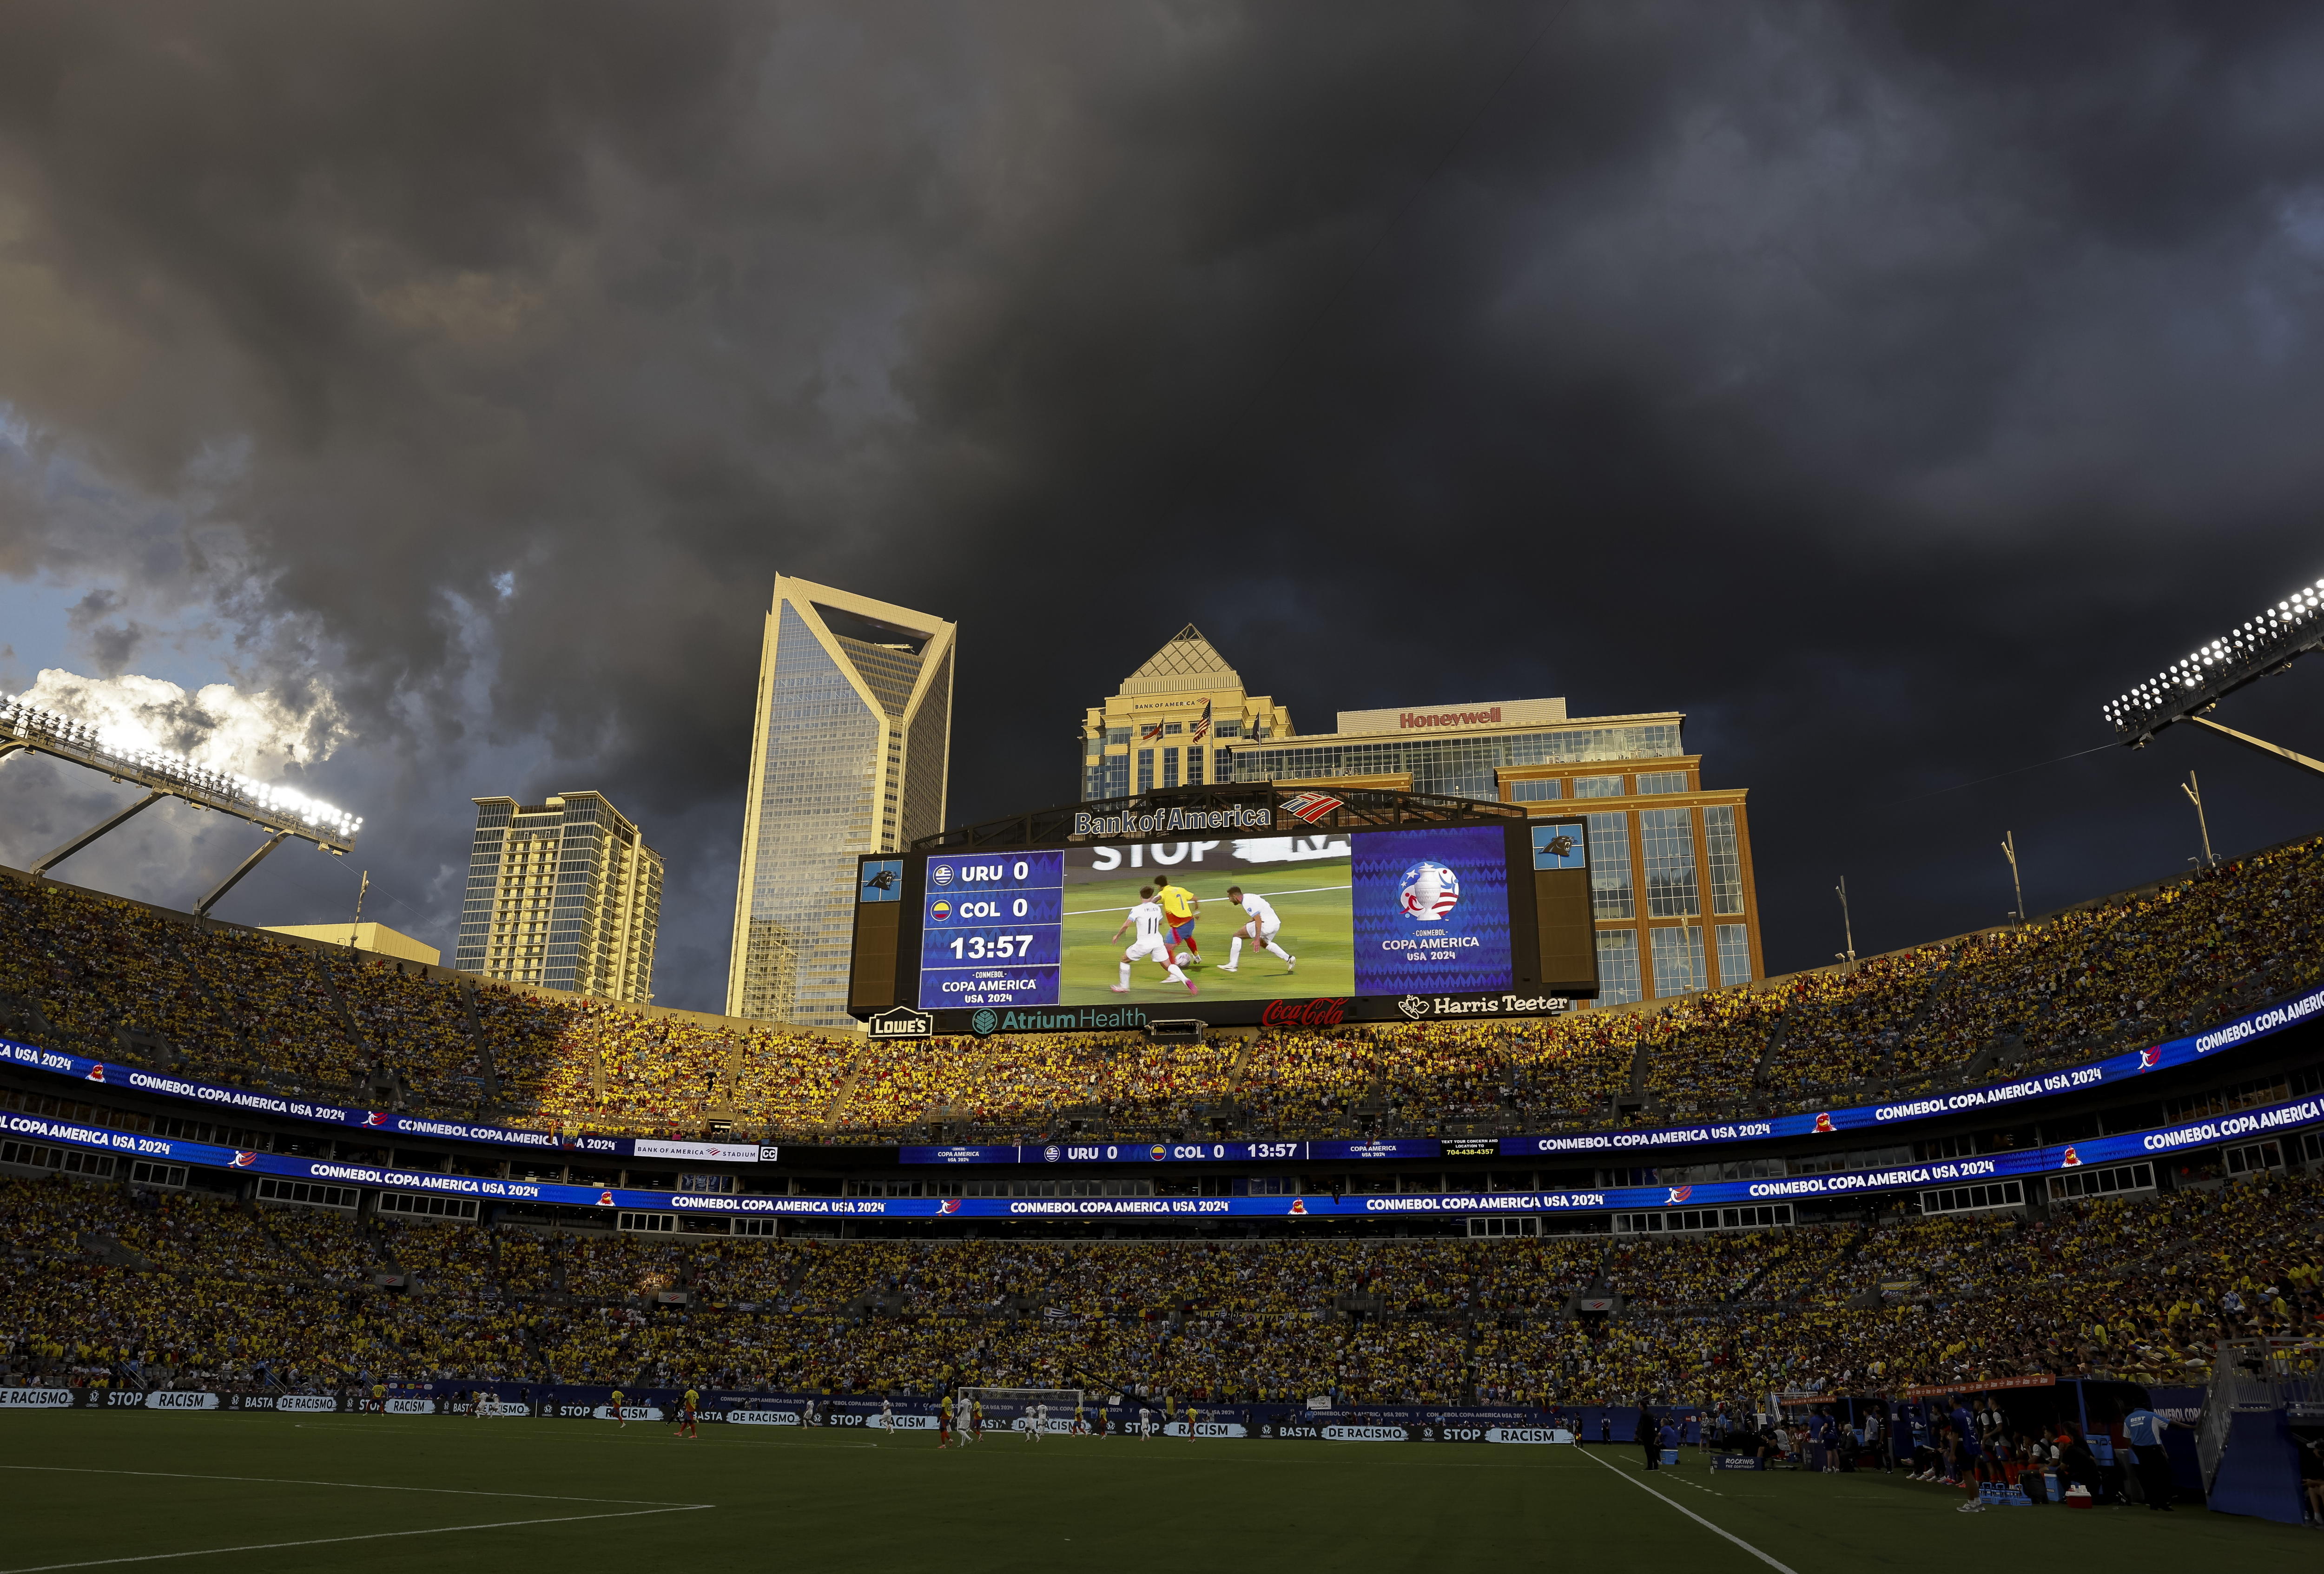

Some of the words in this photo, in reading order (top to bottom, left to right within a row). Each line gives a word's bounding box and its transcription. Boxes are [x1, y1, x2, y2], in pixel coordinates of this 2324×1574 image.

[1400, 707, 1501, 728] Honeywell
[1075, 810, 1137, 835] Bank
[1139, 808, 1165, 831] of
[1167, 804, 1271, 830] America
[962, 865, 1003, 881] URU
[1014, 862, 1028, 879] 0
[960, 902, 1000, 918] COL
[1013, 899, 1027, 916] 0
[1176, 894, 1184, 911] 7
[1148, 917, 1157, 934] 11
[951, 935, 1033, 959] 13:57
[1382, 940, 1417, 950] COPA
[1420, 937, 1479, 948] AMERICA
[1407, 952, 1426, 961] USA
[1431, 951, 1455, 960] 2024
[943, 981, 976, 992] COPA
[978, 980, 1036, 991] AMERICA
[965, 994, 984, 1003] USA
[988, 994, 1011, 1002] 2024
[1434, 997, 1498, 1014] Harris
[1502, 995, 1567, 1011] Teeter
[1002, 1010, 1075, 1030] Atrium
[1081, 1008, 1146, 1028] Health
[1262, 997, 1349, 1026] Coca-Cola
[2196, 1021, 2255, 1052] CONMEBOL
[2256, 1009, 2287, 1031] COPA
[15, 1047, 38, 1063] USA
[41, 1054, 71, 1070] 2024
[130, 1073, 195, 1096] CONMEBOL
[198, 1087, 231, 1102] COPA
[232, 1094, 286, 1112] AMERICA
[290, 1103, 312, 1117] USA
[315, 1107, 344, 1120] 2024
[1876, 1099, 1948, 1120] CONMEBOL
[1949, 1093, 1987, 1108] COPA
[1987, 1081, 2042, 1103] AMERICA
[2045, 1075, 2070, 1090] USA
[2072, 1067, 2101, 1085] 2024
[2144, 1124, 2220, 1149] CONMEBOL
[2221, 1116, 2259, 1135] COPA
[2261, 1102, 2320, 1128] AMERICA
[10, 1118, 47, 1135] COPA
[48, 1125, 108, 1145] AMERICA
[113, 1135, 135, 1150] USA
[139, 1139, 170, 1154] 2024
[398, 1120, 468, 1137] CONMEBOL
[471, 1128, 503, 1140] COPA
[562, 1137, 584, 1148] UA
[587, 1139, 614, 1150] 2024
[1539, 1137, 1611, 1150] CONMEBOL
[1613, 1135, 1649, 1146] COPA
[1651, 1130, 1709, 1144] AMERICA
[1711, 1126, 1737, 1138] USA
[1739, 1124, 1770, 1136] 2024
[762, 1149, 776, 1159] CC
[1068, 1148, 1098, 1159] URU
[1108, 1146, 1117, 1159] 0
[1175, 1146, 1205, 1158] COL
[1214, 1145, 1224, 1158] 0
[1248, 1144, 1297, 1157] 13:57
[311, 1164, 382, 1182] CONMEBOL
[385, 1173, 420, 1186] COPA
[421, 1177, 478, 1192] AMERICA
[482, 1183, 505, 1195] USA
[508, 1185, 538, 1197] 2024
[1750, 1179, 1827, 1196] CONMEBOL
[1828, 1176, 1866, 1189] COPA
[1868, 1169, 1930, 1186] AMERICA
[1933, 1165, 1959, 1179] USA
[1961, 1160, 1994, 1175] 2024
[672, 1197, 740, 1209] CONMEBOL
[742, 1200, 773, 1210] COPA
[775, 1201, 828, 1212] AMERICA
[832, 1202, 855, 1212] USA
[858, 1202, 884, 1212] 2024
[1011, 1203, 1078, 1212] CONMEBOL
[1080, 1202, 1113, 1212] COPA
[1114, 1202, 1169, 1212] AMERICA
[1173, 1201, 1196, 1212] USA
[1199, 1201, 1228, 1211] 2024
[1367, 1199, 1440, 1210] CONMEBOL
[1442, 1198, 1478, 1209] COPA
[1479, 1197, 1541, 1208] AMERICA
[1544, 1196, 1569, 1206] USA
[1571, 1194, 1603, 1205] 2024
[11, 1391, 67, 1403] RACISMO
[108, 1392, 142, 1405] STOP
[159, 1394, 204, 1407] RACISM
[245, 1397, 272, 1407] BASTA
[282, 1398, 293, 1408] DE
[295, 1398, 333, 1409] RACISMO
[394, 1401, 424, 1411] RACISM
[560, 1406, 590, 1416] STOP
[749, 1413, 794, 1423] RACISMO
[831, 1415, 862, 1425] STOP
[881, 1417, 925, 1427] ACISM
[1281, 1427, 1316, 1436] BASTA
[1329, 1428, 1343, 1437] DE
[1348, 1429, 1402, 1438] RACISMO
[1444, 1429, 1480, 1440] STOP
[1501, 1430, 1554, 1441] RACISM
